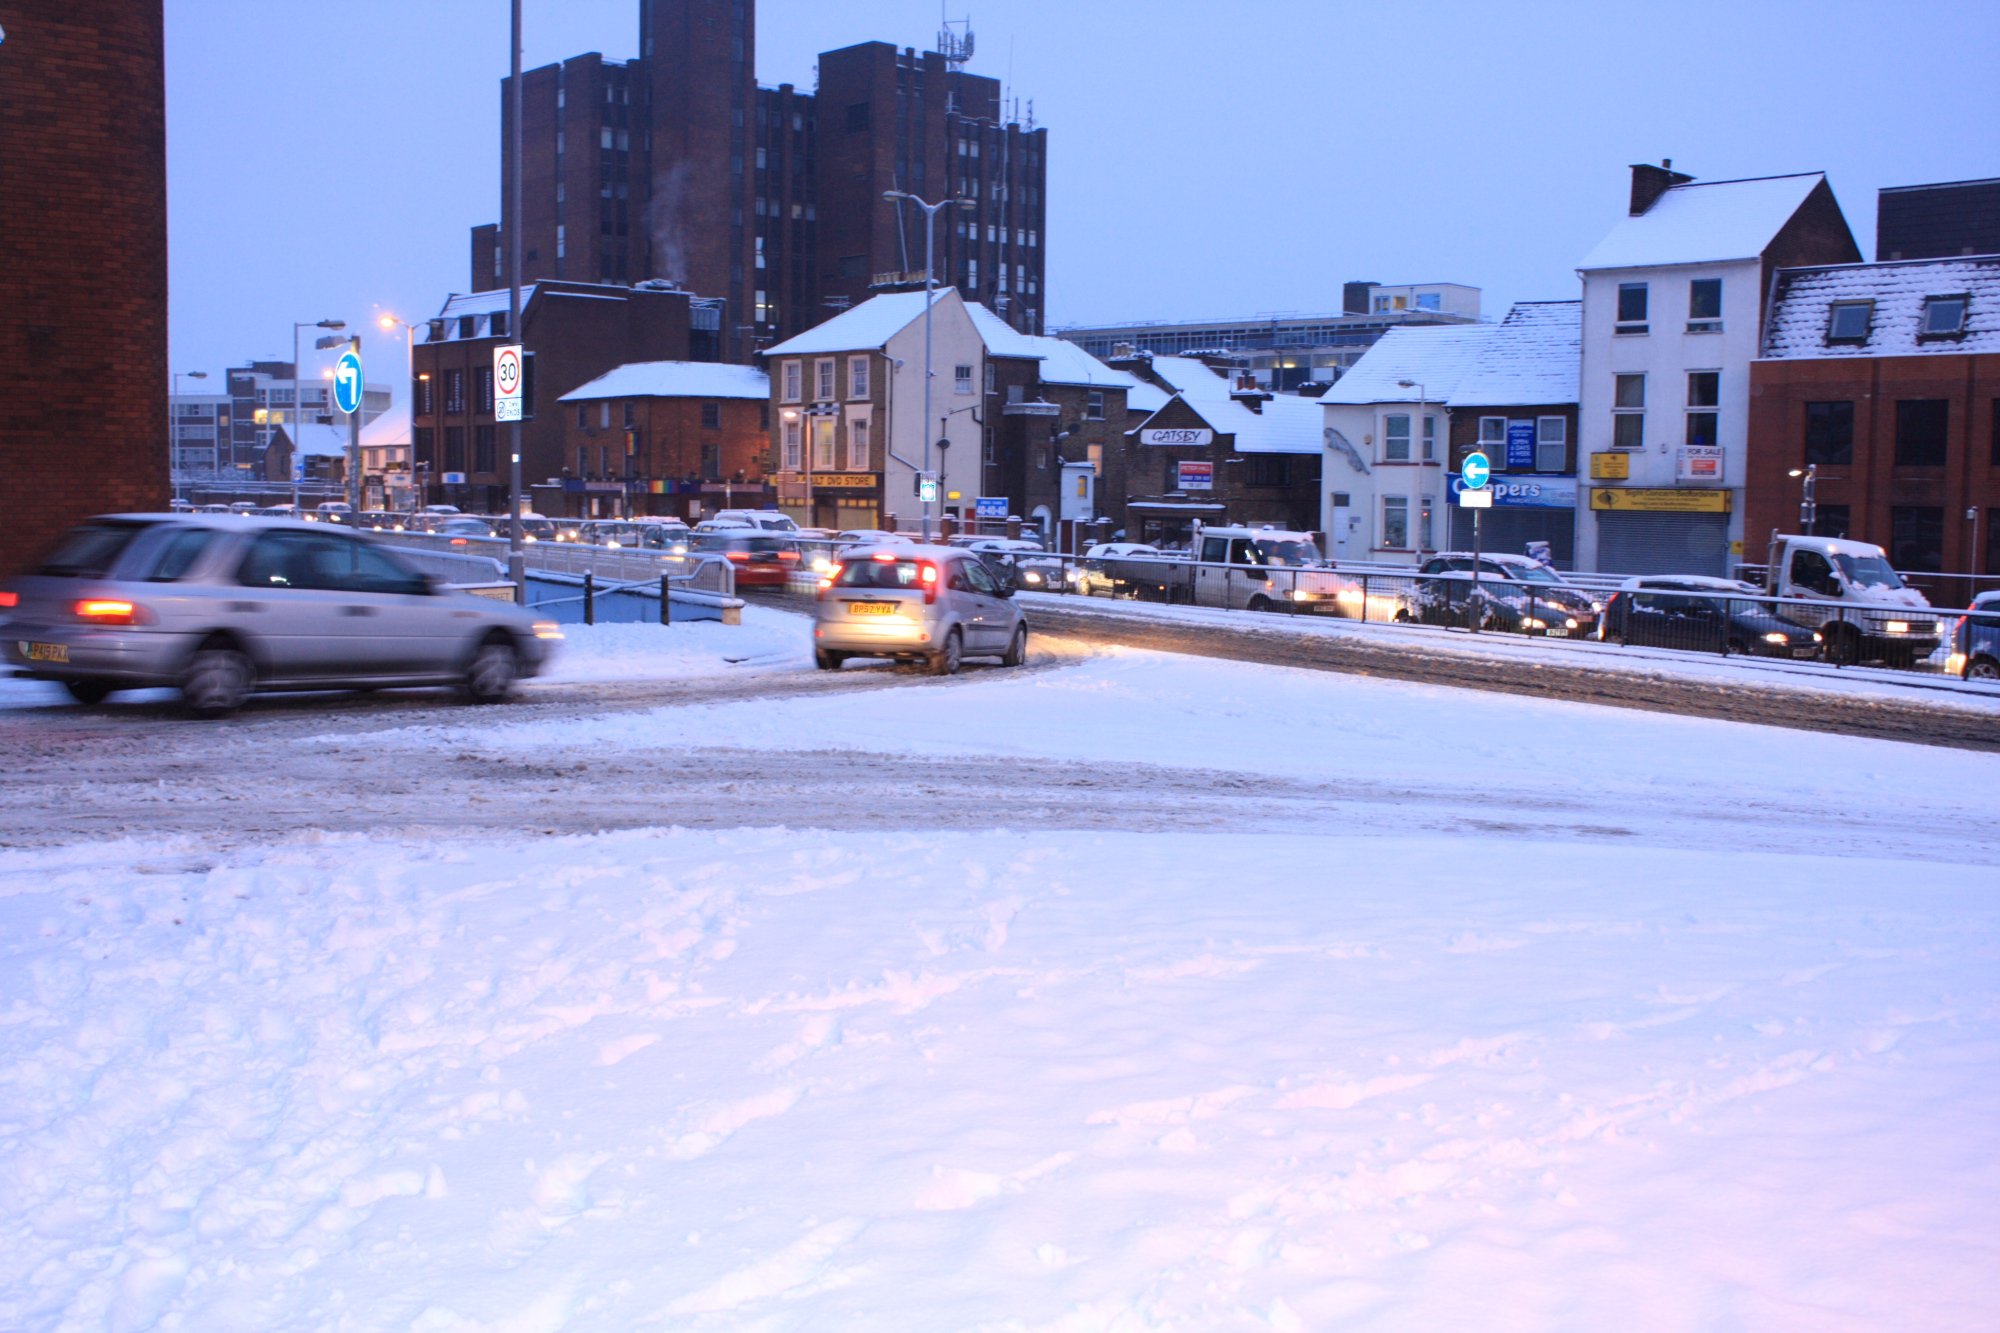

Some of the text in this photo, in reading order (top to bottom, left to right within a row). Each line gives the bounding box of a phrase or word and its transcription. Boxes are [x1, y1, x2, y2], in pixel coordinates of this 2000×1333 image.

[500, 363, 516, 381] 30
[1152, 430, 1202, 442] GATSBY
[802, 476, 824, 485] AULT
[827, 476, 842, 486] DVD
[844, 476, 870, 486] STORE
[1452, 478, 1541, 500] Cppers
[1625, 489, 1643, 498] Sight
[876, 606, 891, 614] YYA
